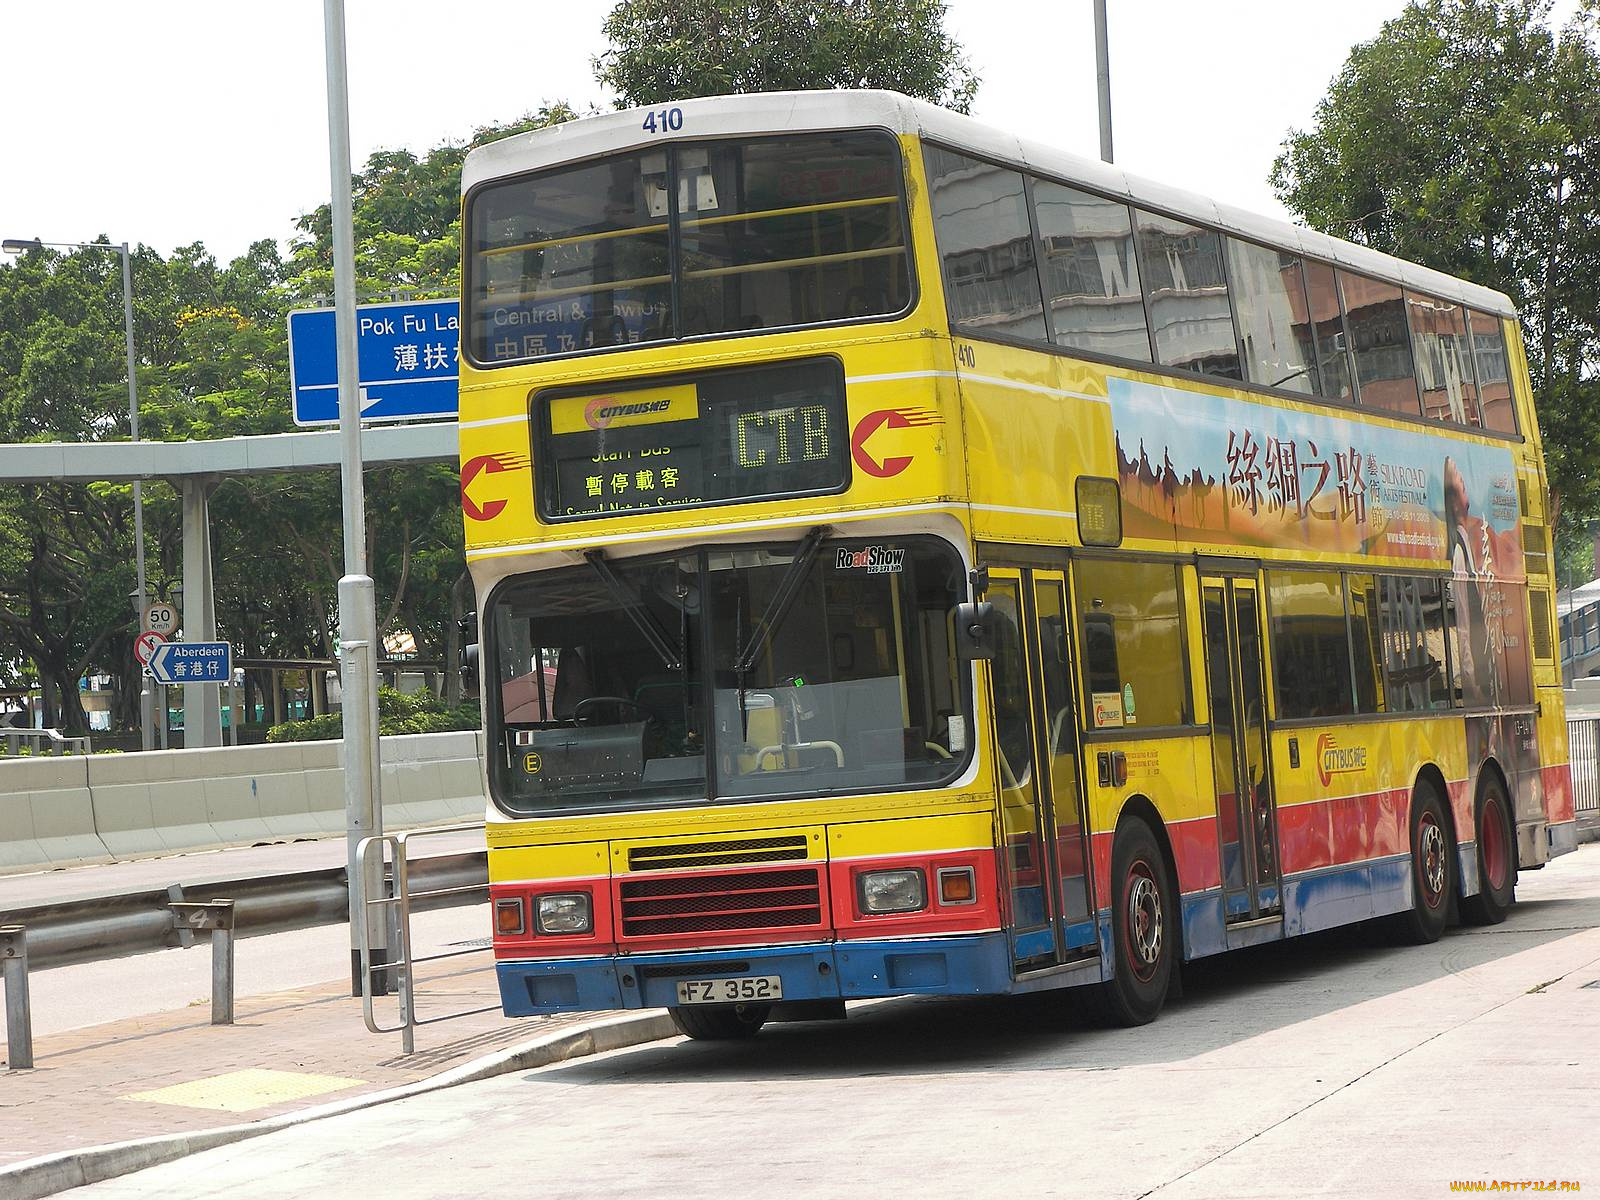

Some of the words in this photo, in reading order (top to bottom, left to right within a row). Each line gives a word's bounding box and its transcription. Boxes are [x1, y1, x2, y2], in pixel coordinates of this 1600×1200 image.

[643, 108, 683, 133] 410
[494, 304, 563, 326] Central
[571, 302, 586, 320] &
[360, 318, 395, 336] Pok
[403, 315, 426, 333] Fu
[959, 344, 976, 368] 410
[738, 405, 829, 468] CTB
[585, 467, 679, 497] 暫停載客
[835, 546, 906, 569] RoadShow
[150, 609, 170, 622] 50
[174, 647, 224, 657] Aberdeen
[174, 661, 219, 677] 香港仔
[526, 755, 538, 770] E
[1324, 748, 1354, 770] CITYBUS
[189, 909, 209, 928] 4
[686, 982, 715, 1001] FZ
[725, 979, 771, 999] 352
